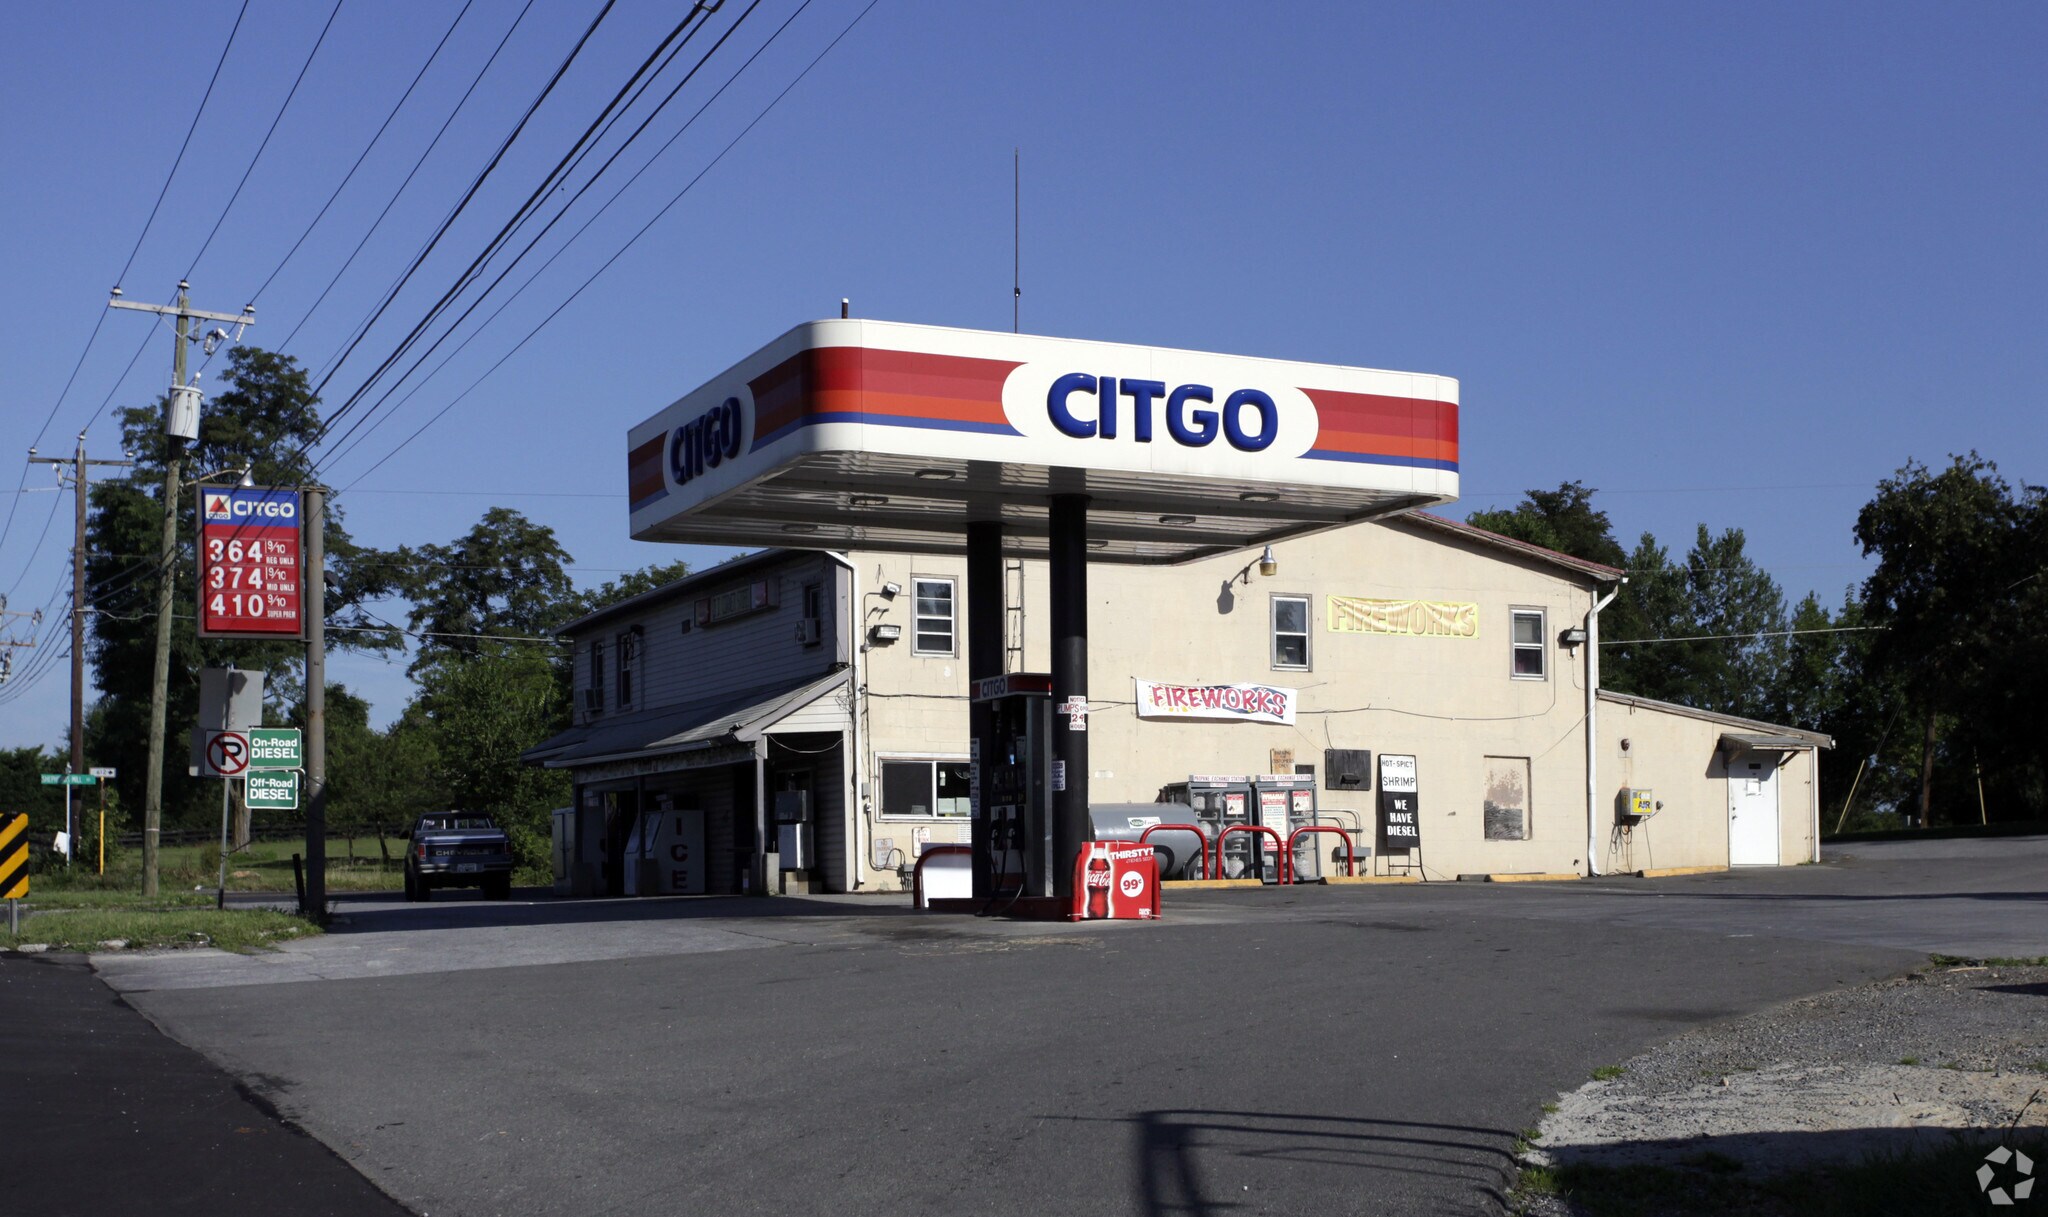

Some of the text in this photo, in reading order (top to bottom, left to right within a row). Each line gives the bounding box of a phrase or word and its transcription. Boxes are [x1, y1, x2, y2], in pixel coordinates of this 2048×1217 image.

[1047, 371, 1279, 452] CITGO
[669, 395, 742, 486] CITGO
[233, 500, 295, 518] CITGO
[209, 539, 286, 563] 364 9/10
[266, 556, 295, 565] REG UNLD
[210, 566, 287, 589] 374 9/10
[266, 583, 295, 592] MID UNLD
[210, 594, 287, 617] 410 9/10
[267, 610, 296, 618] SUPER PREM
[1332, 600, 1475, 636] FIREWORKS
[982, 678, 1006, 698] CITGO
[1152, 686, 1286, 716] FIREWORKS
[252, 737, 298, 748] On-Road
[251, 748, 298, 759] DIESEL
[250, 777, 293, 788] Off-Road
[1382, 776, 1416, 787] SHRIMP
[250, 788, 293, 800] DIESEL
[1394, 799, 1408, 810] WE
[1637, 800, 1651, 809] AIR
[1389, 812, 1413, 824] HAVE
[1387, 825, 1418, 836] DIESEL
[671, 817, 688, 889] ICE
[1110, 847, 1154, 860] THIRSTY?
